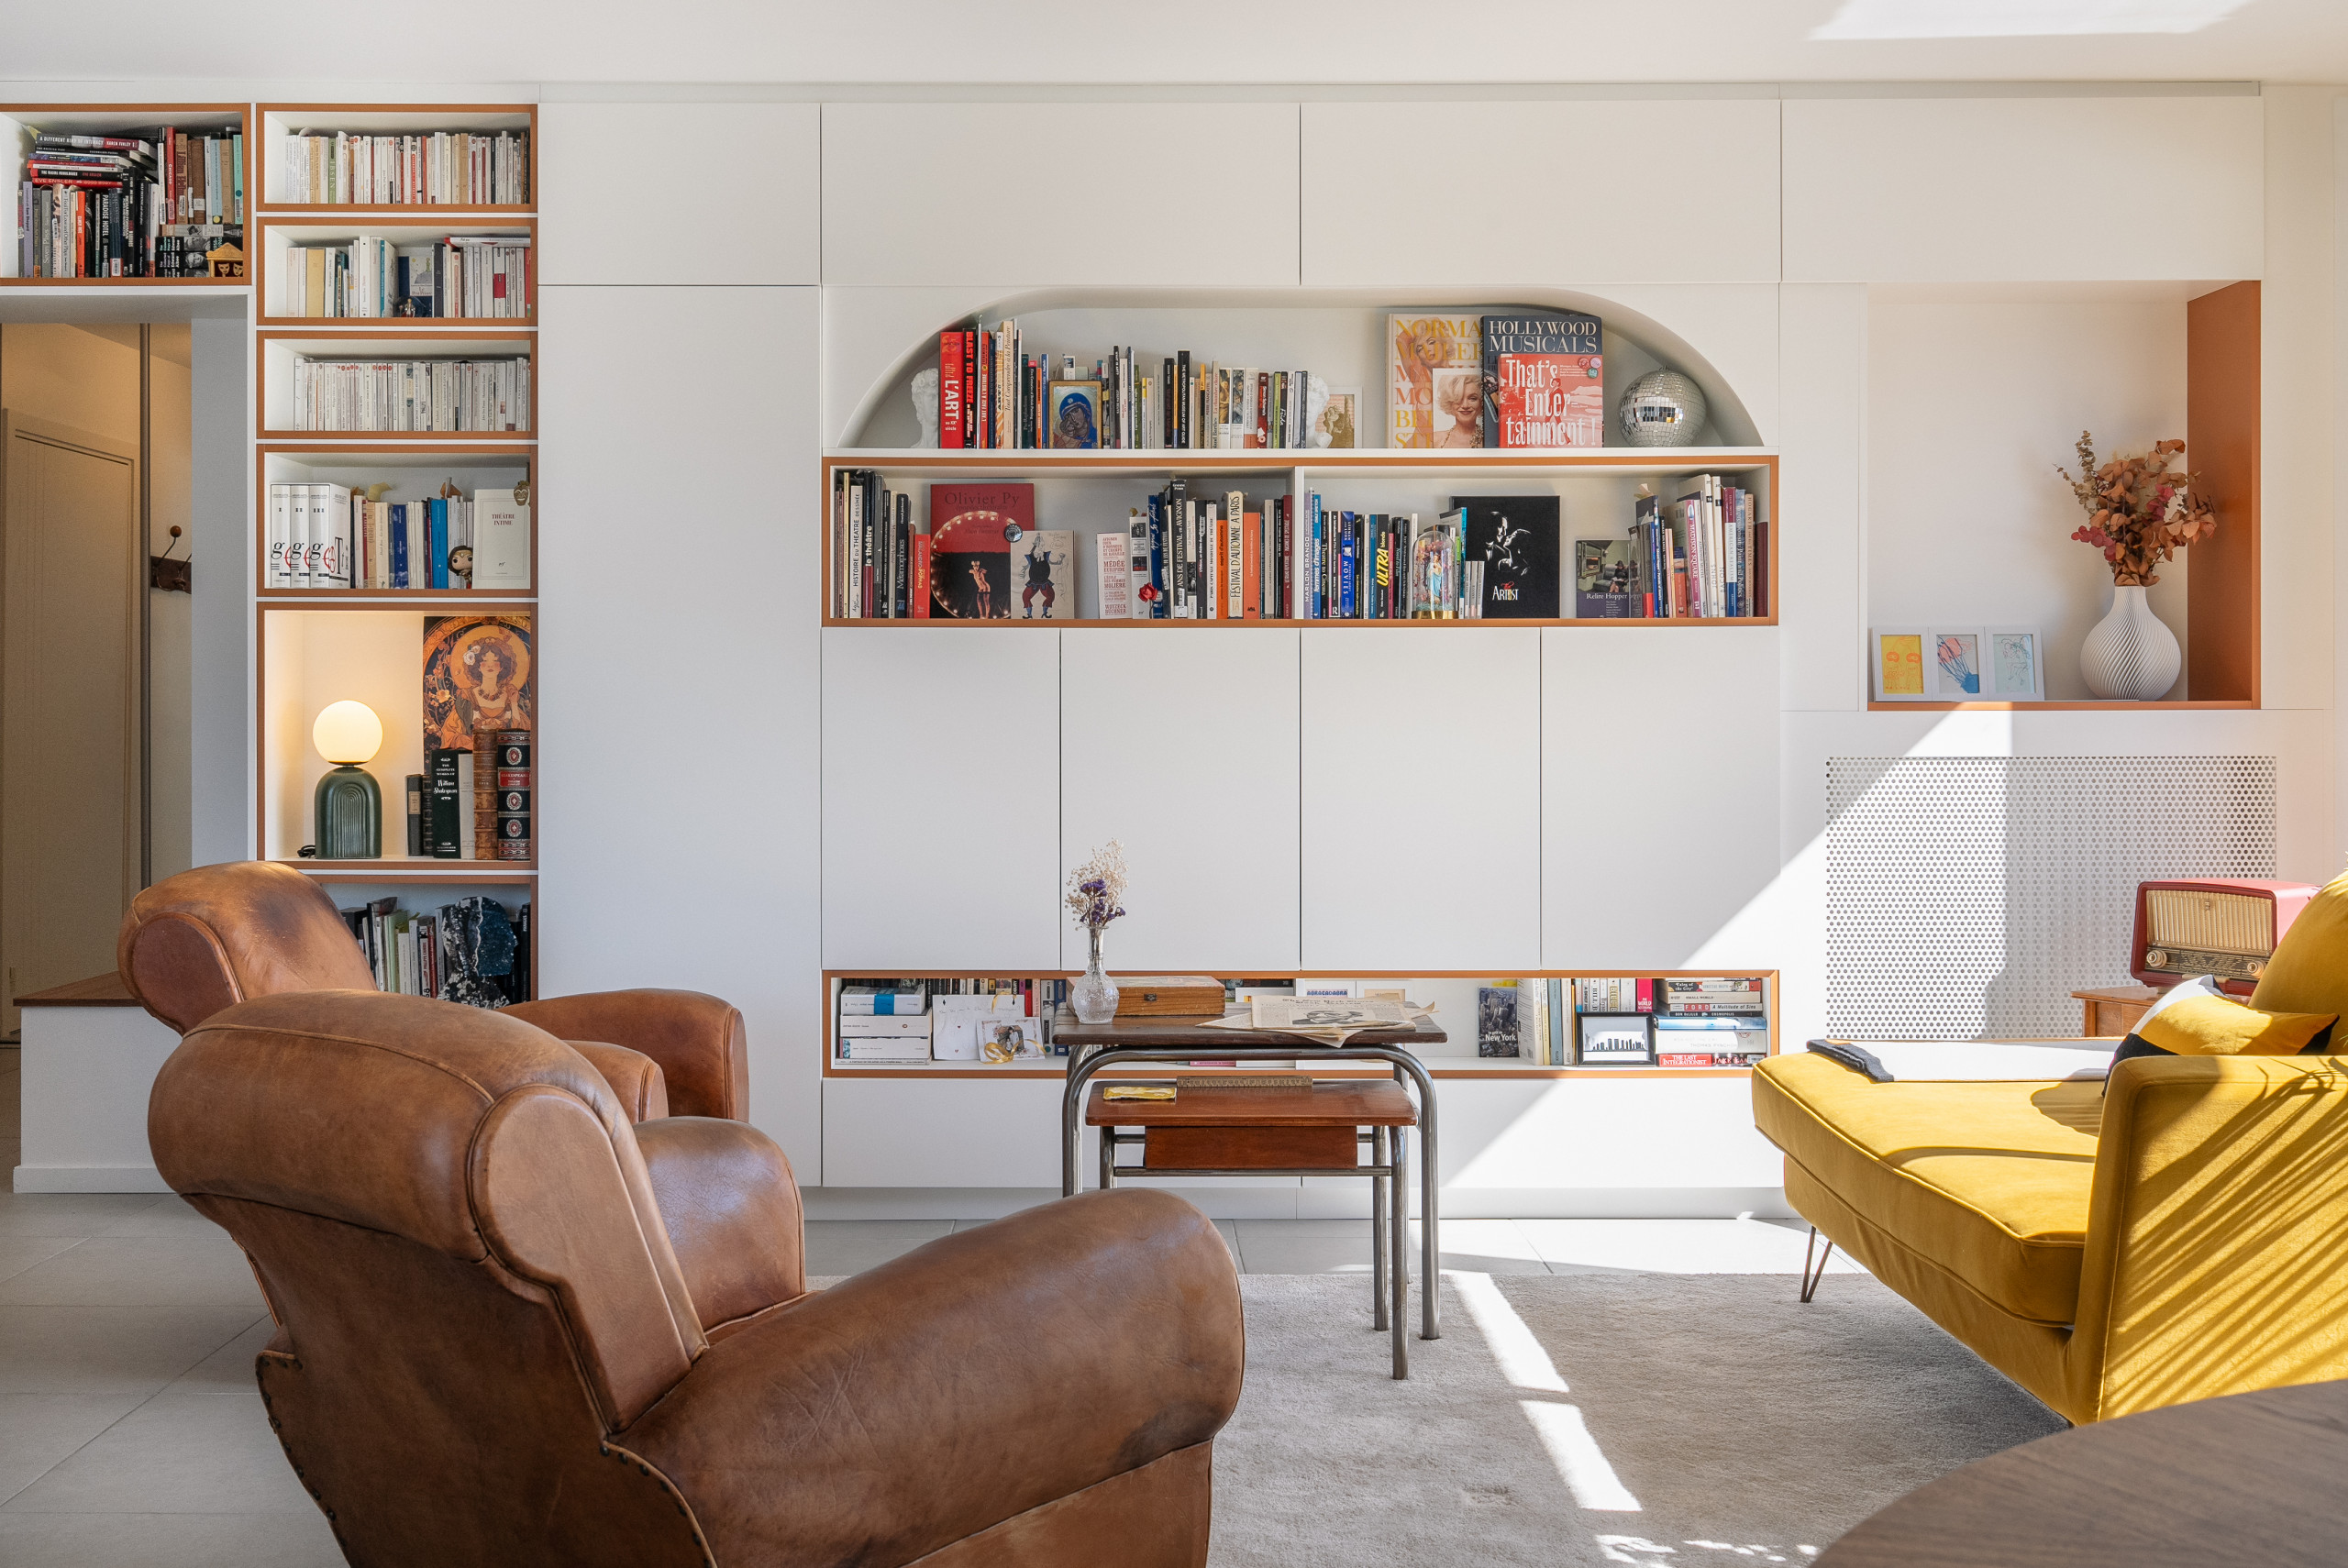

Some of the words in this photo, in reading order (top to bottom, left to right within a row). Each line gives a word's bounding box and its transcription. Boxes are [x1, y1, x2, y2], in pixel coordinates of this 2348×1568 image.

[1396, 319, 1481, 337] NORMA
[1489, 320, 1597, 337] HOLLYWOOD
[966, 331, 974, 359] BLAST
[1489, 336, 1597, 354] MUSICALS
[966, 361, 974, 373] TO
[1505, 359, 1558, 388] That's
[945, 380, 959, 420] L'ART
[966, 375, 974, 404] FREEZE
[1525, 388, 1571, 417] Enter
[1505, 416, 1585, 446] tainment
[945, 491, 996, 504] Olivier
[1002, 491, 1019, 507] Py
[1175, 498, 1183, 526] AVIGNON
[1229, 496, 1240, 516] PARIS
[1175, 534, 1183, 562] FESTIVAL
[1230, 525, 1241, 565] D'AUTOMNE
[865, 558, 872, 567] le
[897, 539, 906, 590] Métamorphoses
[1175, 564, 1183, 572] DE
[1377, 548, 1389, 587] ULTRA
[1175, 574, 1183, 587] ANS
[1230, 568, 1241, 598] FESTIVAL
[1491, 586, 1519, 601] ARTIST
[1610, 986, 1618, 1004] BILL
